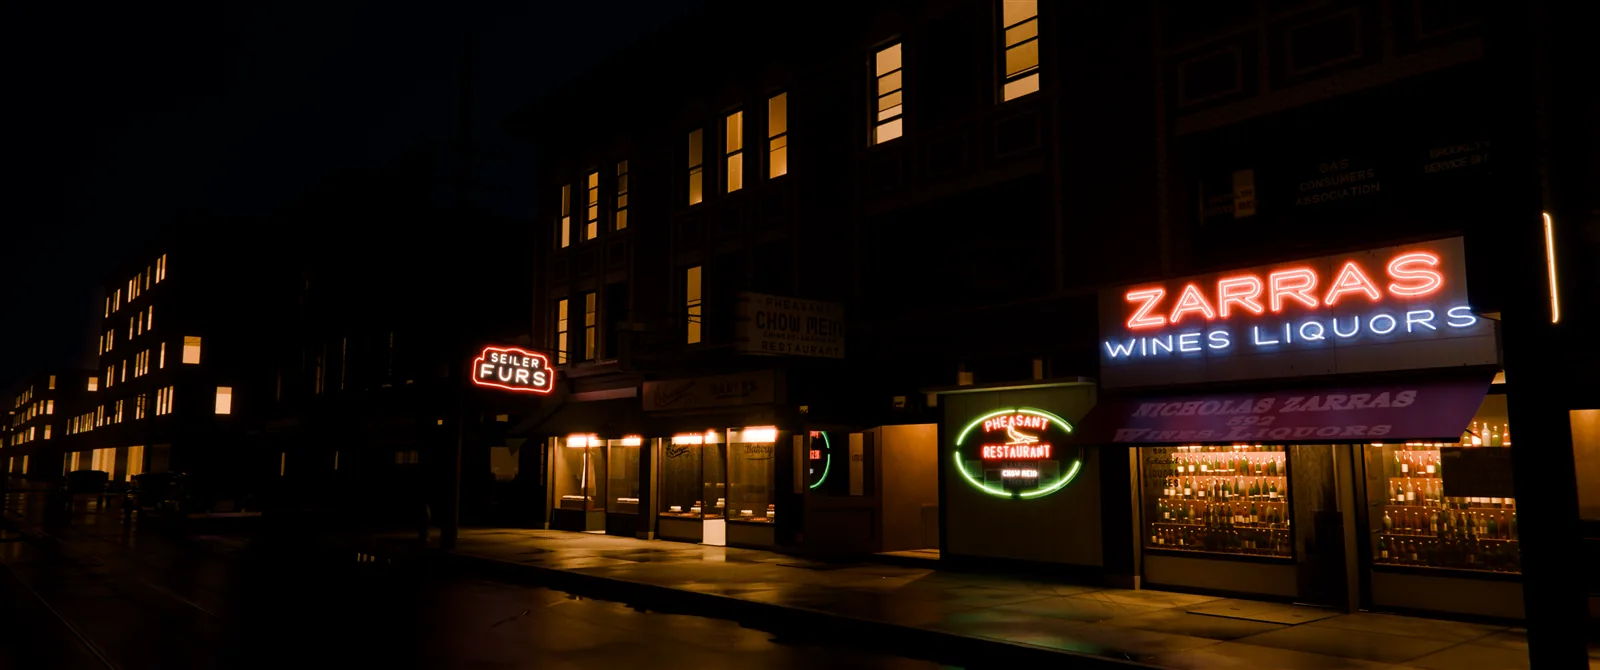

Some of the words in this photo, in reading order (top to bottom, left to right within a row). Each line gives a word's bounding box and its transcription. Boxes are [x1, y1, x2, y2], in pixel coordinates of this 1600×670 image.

[1318, 158, 1350, 173] GAS
[1299, 168, 1375, 191] CONSUMERS
[1295, 182, 1380, 207] ASSOCIATION
[1125, 252, 1444, 329] ZARRAS
[766, 297, 833, 314] PHEASANT
[756, 309, 800, 332] CHOW
[807, 317, 843, 338] MEIN
[1105, 330, 1230, 358] WINES
[1253, 305, 1478, 346] LIQUORS
[761, 341, 840, 357] RESTAURANT
[491, 352, 539, 368] SEILER
[480, 363, 545, 387] FURS
[1131, 396, 1276, 417] NICHOLAS
[1279, 390, 1417, 413] ZARRAS
[984, 414, 1049, 432] PHEASANT
[1226, 415, 1276, 426] 592
[983, 444, 1051, 459] RESTAURANT
[1002, 469, 1020, 478] CHOW
